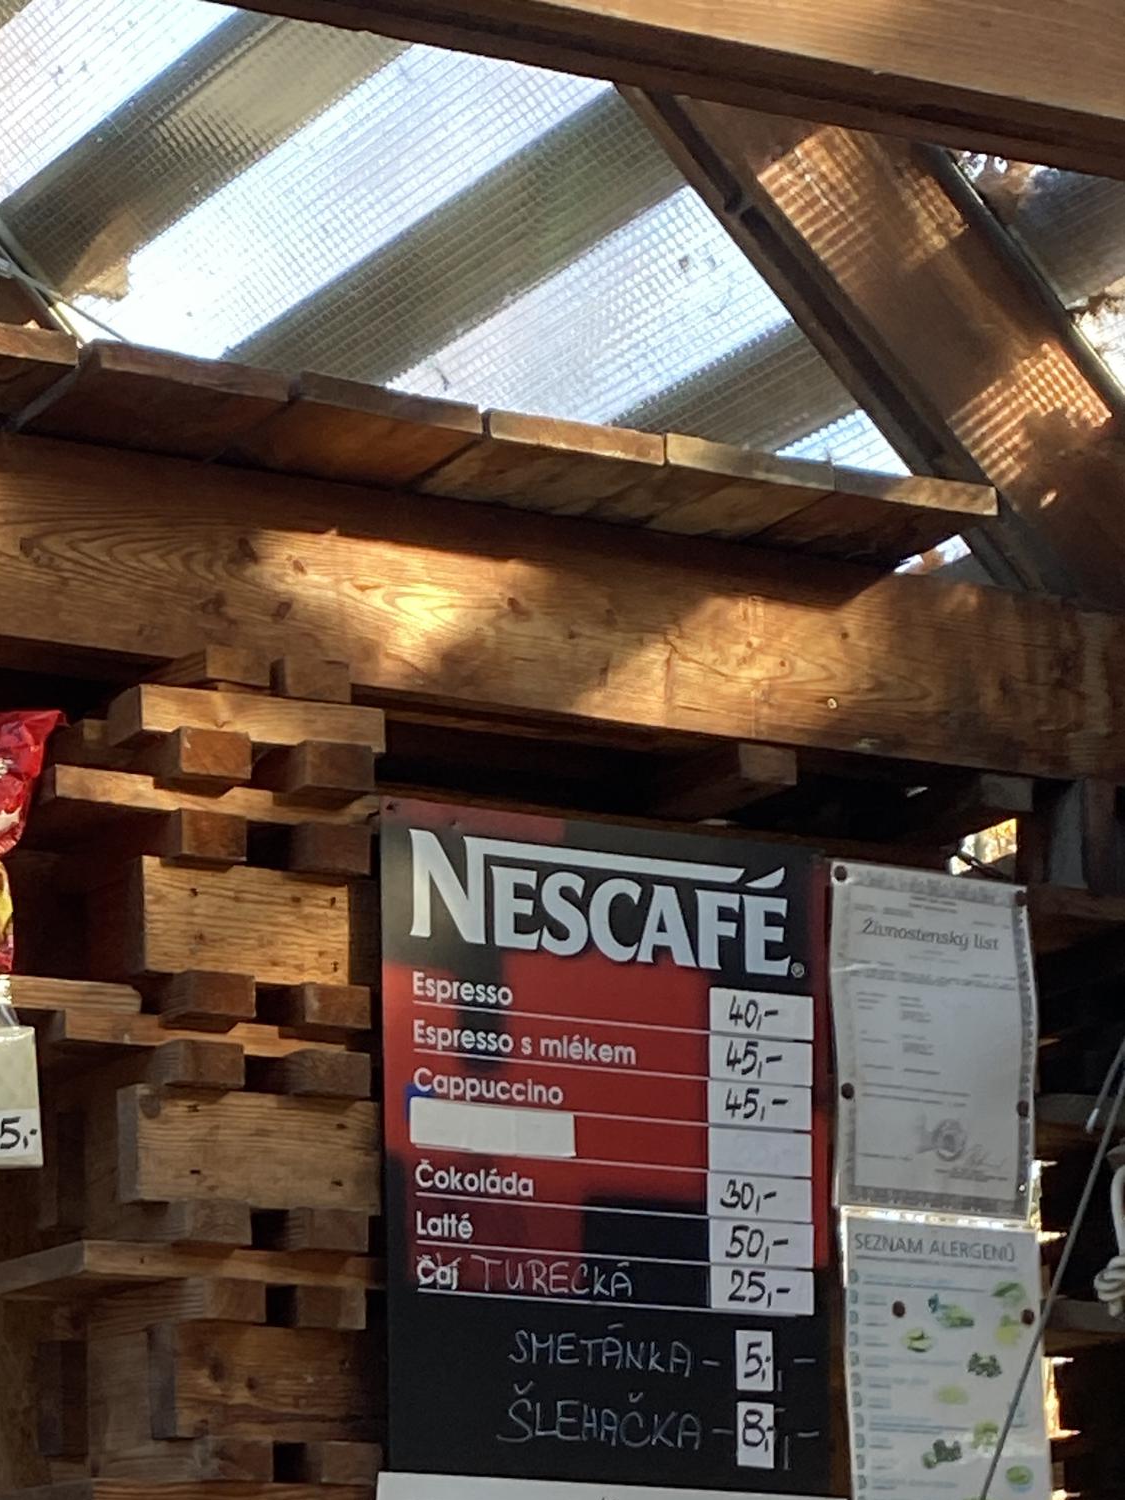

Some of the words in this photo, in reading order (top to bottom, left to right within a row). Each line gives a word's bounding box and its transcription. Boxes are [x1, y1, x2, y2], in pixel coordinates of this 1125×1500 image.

[408, 828, 793, 977] NESCAFÉ
[974, 934, 999, 950] list
[413, 972, 513, 1006] Espresso
[728, 1000, 779, 1031] 40,-
[413, 1019, 514, 1054] Espresso
[521, 1034, 531, 1055] s
[539, 1035, 637, 1066] mlékem
[725, 1040, 783, 1079] 45,-
[413, 1067, 564, 1106] Cappuccino
[725, 1088, 789, 1123] 45,-
[415, 1159, 534, 1197] Čokoláda
[719, 1178, 777, 1213] 30,-
[415, 1210, 474, 1240] Latté
[724, 1224, 790, 1263] 50,-
[854, 1233, 923, 1254] SEZNAM
[930, 1239, 1015, 1262] ALERGENŮ
[470, 1254, 633, 1298] TURECKÁ
[727, 1270, 791, 1303] 25,-
[496, 1380, 702, 1450] ŠLEHAČKA
